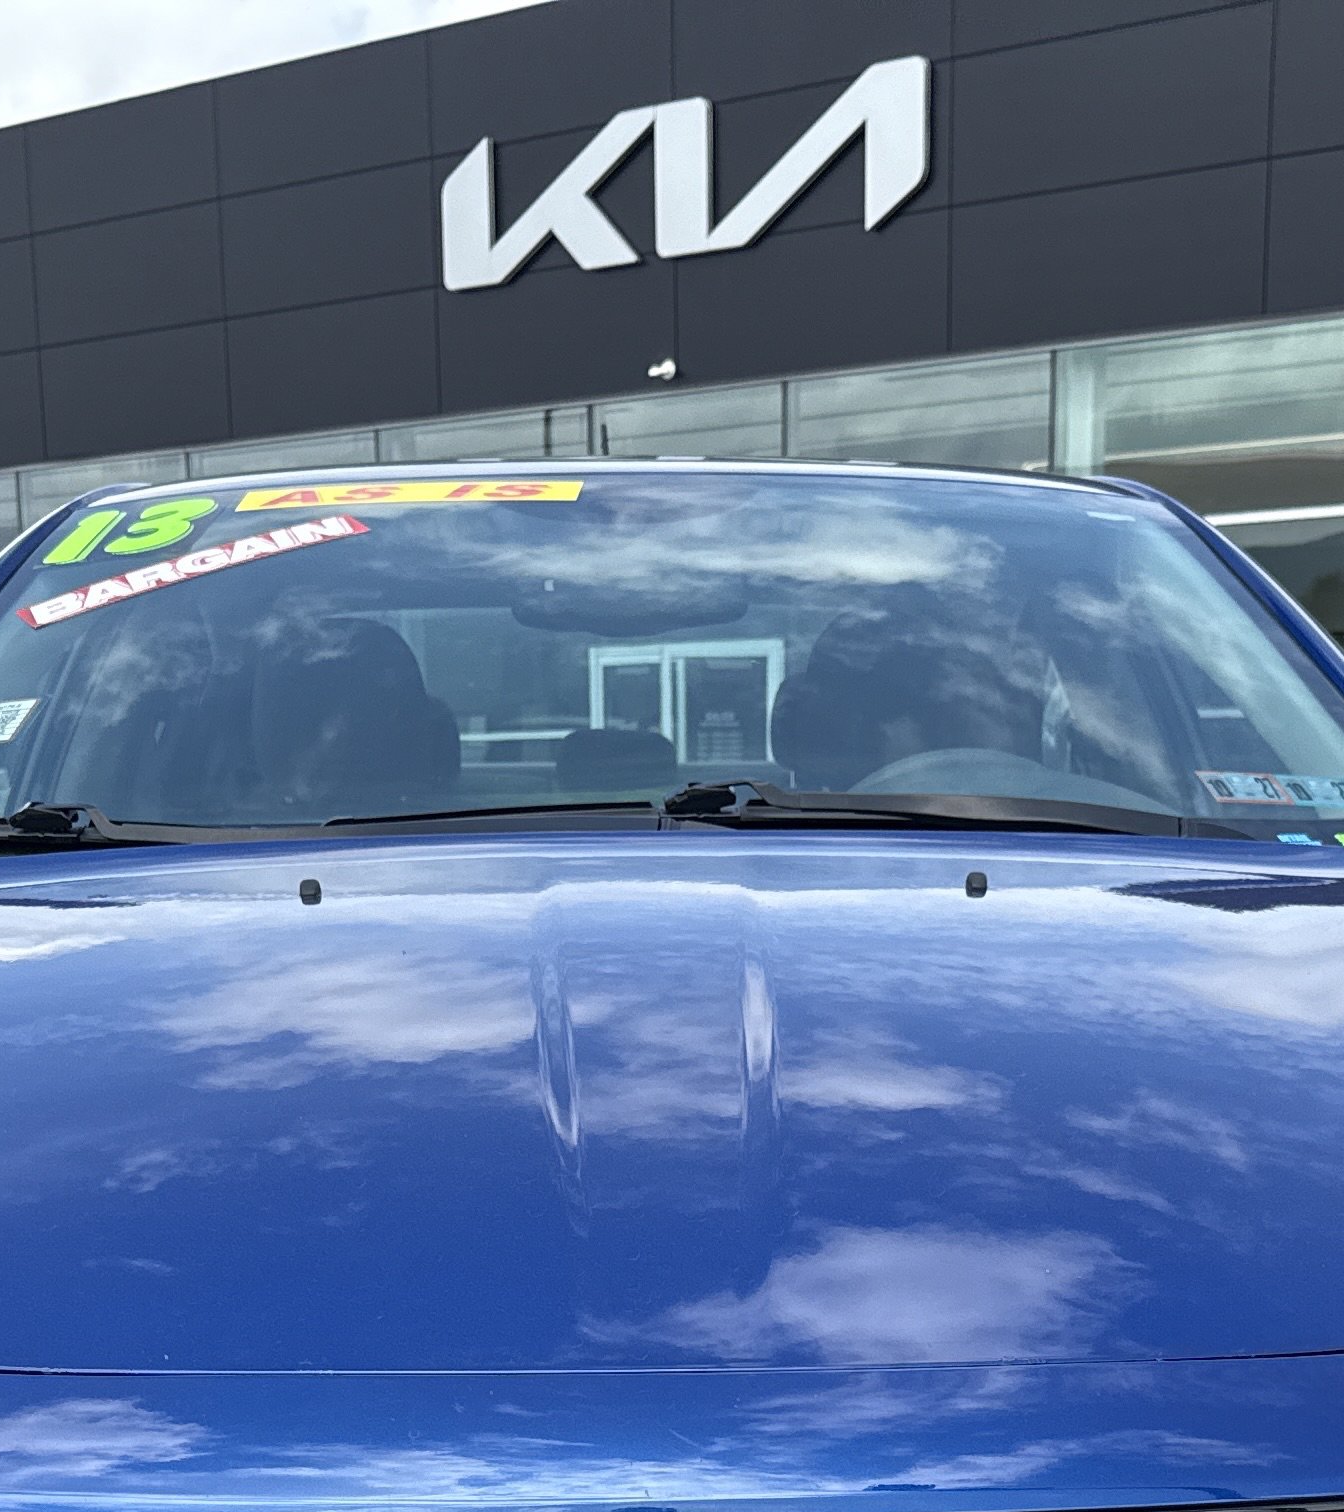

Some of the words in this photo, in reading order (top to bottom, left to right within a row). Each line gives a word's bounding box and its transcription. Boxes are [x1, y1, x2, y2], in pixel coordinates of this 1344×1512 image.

[441, 55, 929, 291] KIA
[43, 498, 218, 565] 13
[259, 486, 401, 508] AS
[443, 484, 552, 500] IS
[29, 515, 354, 626] BARGAIN
